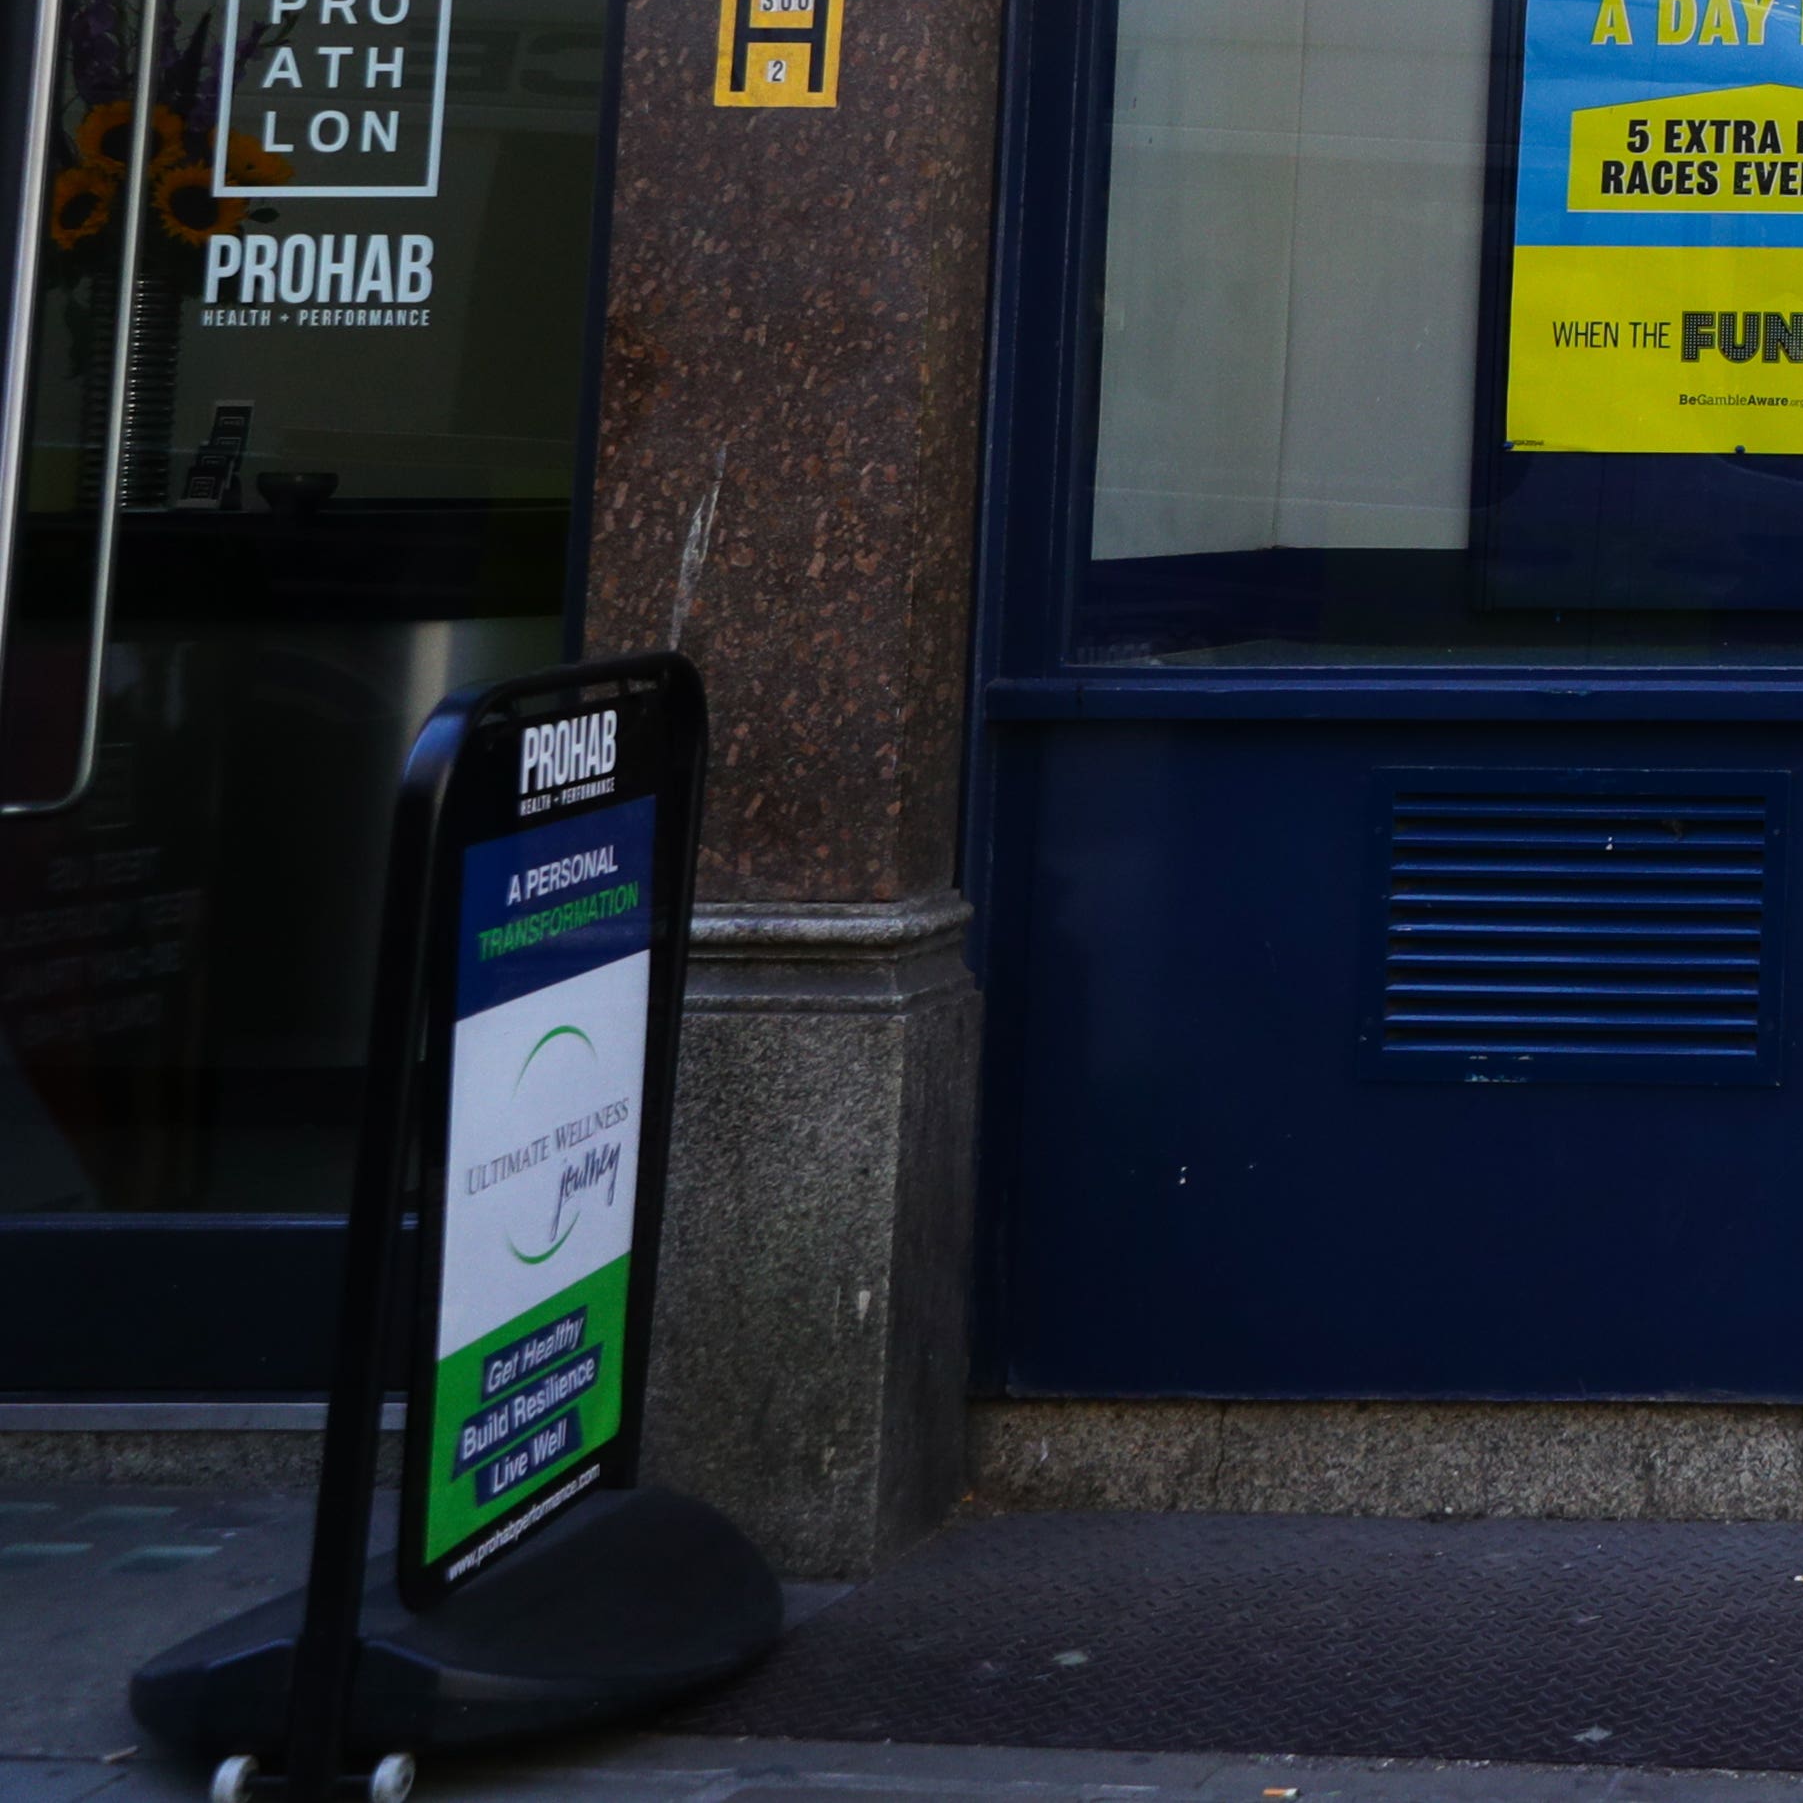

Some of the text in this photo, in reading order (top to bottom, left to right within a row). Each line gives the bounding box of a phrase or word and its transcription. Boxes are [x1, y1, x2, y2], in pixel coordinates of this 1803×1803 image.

[262, 46, 405, 89] ATH
[771, 60, 784, 82] 2
[263, 110, 400, 153] LON
[1626, 119, 1650, 154] 5
[1664, 119, 1782, 154] EXTRA
[1600, 159, 1720, 195] RACES
[203, 234, 435, 304] PROHAB
[203, 309, 272, 326] HEALTH
[299, 309, 431, 326] PERFORMANCE
[1553, 321, 1619, 348] WHEN
[1629, 321, 1671, 349] THE
[519, 709, 618, 795] PROHAB
[518, 793, 552, 817] HEALTH
[561, 776, 616, 807] PERFORMANCE
[506, 844, 619, 907] A PERSONAL
[477, 880, 640, 963] TRANSFORMATION
[466, 1097, 630, 1196] ULTIMATE WELLNESS
[486, 1315, 585, 1395] Get Healthy
[461, 1356, 597, 1462] Build Resilience
[491, 1416, 569, 1495] Live Well
